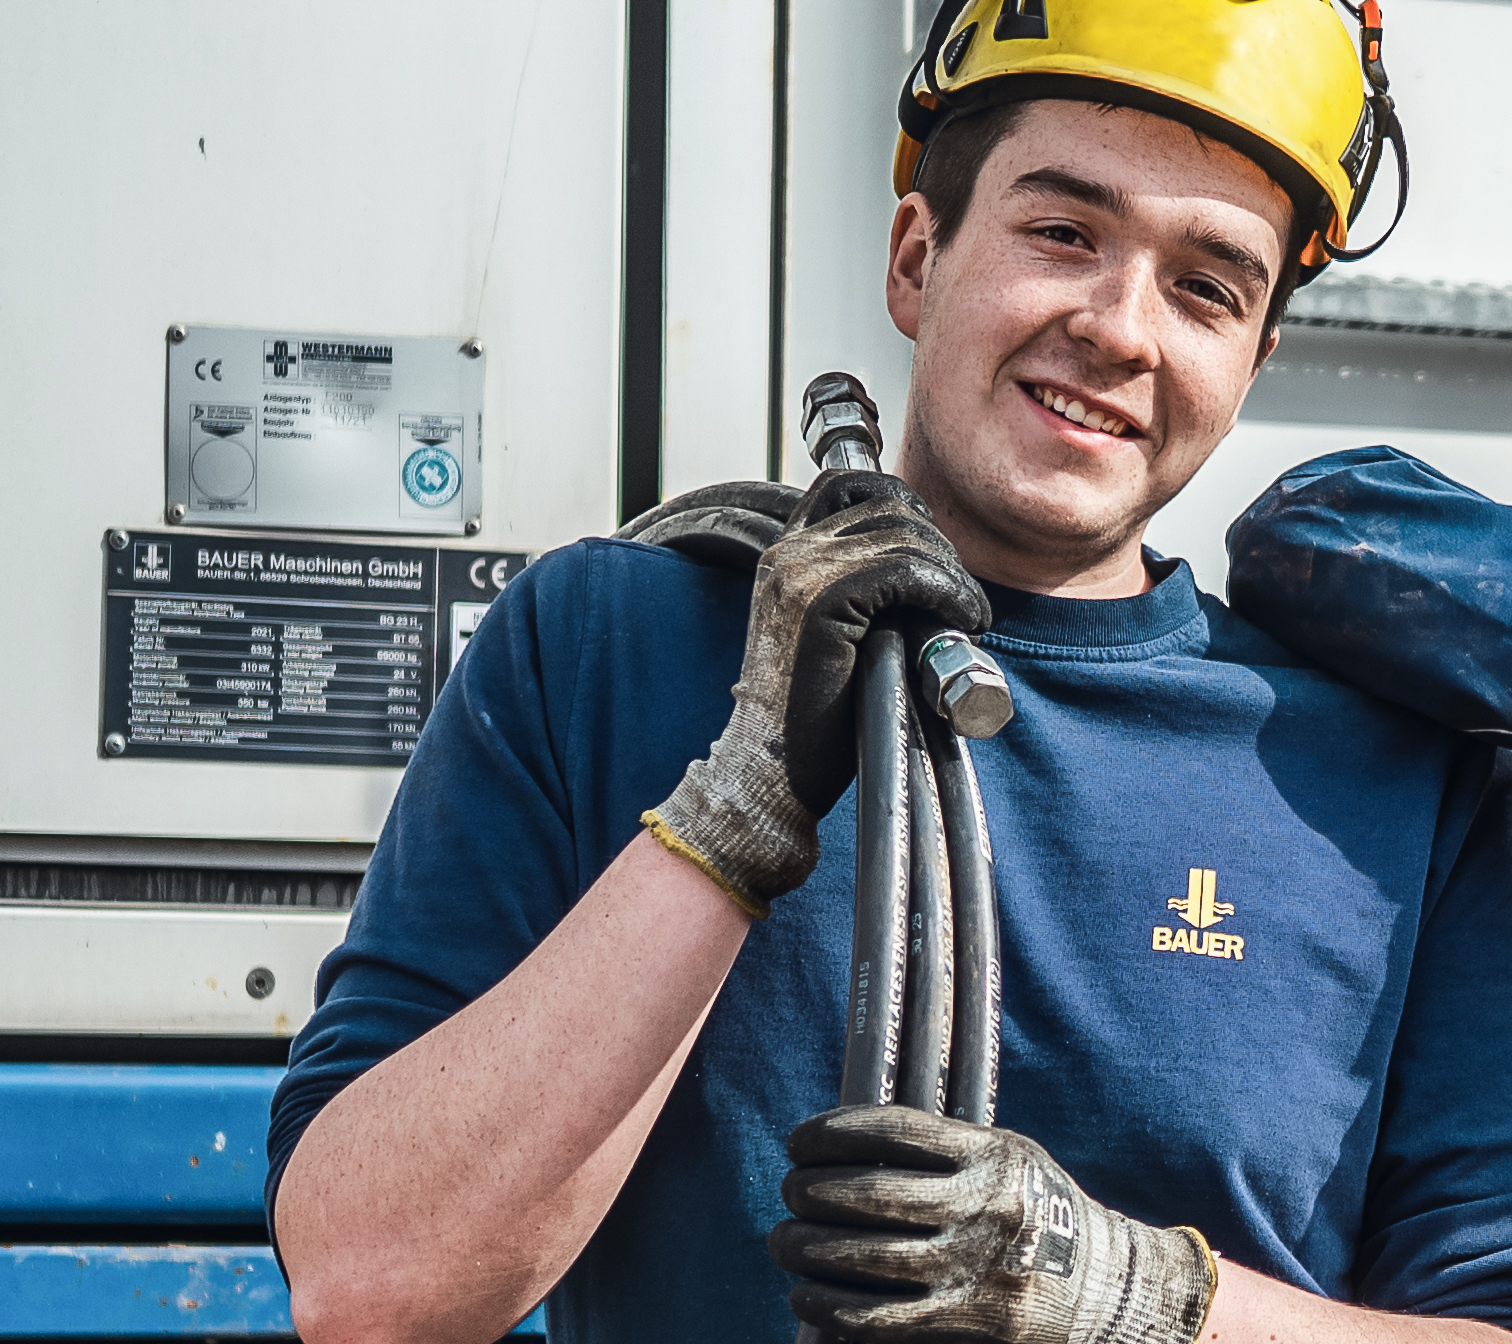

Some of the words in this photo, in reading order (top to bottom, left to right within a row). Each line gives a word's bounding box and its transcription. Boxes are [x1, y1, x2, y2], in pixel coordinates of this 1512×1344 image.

[301, 341, 393, 357] WESTERMANN
[135, 568, 170, 581] BAUER
[197, 549, 264, 570] BAUER
[269, 553, 363, 575] Maschinen
[368, 557, 423, 579] GmbH
[251, 626, 272, 638] 2021
[893, 685, 909, 725] (M2)
[895, 806, 910, 860] MSHA
[890, 902, 908, 966] EN856
[1151, 925, 1244, 961] BAUER
[883, 966, 905, 1067] REPLACES
